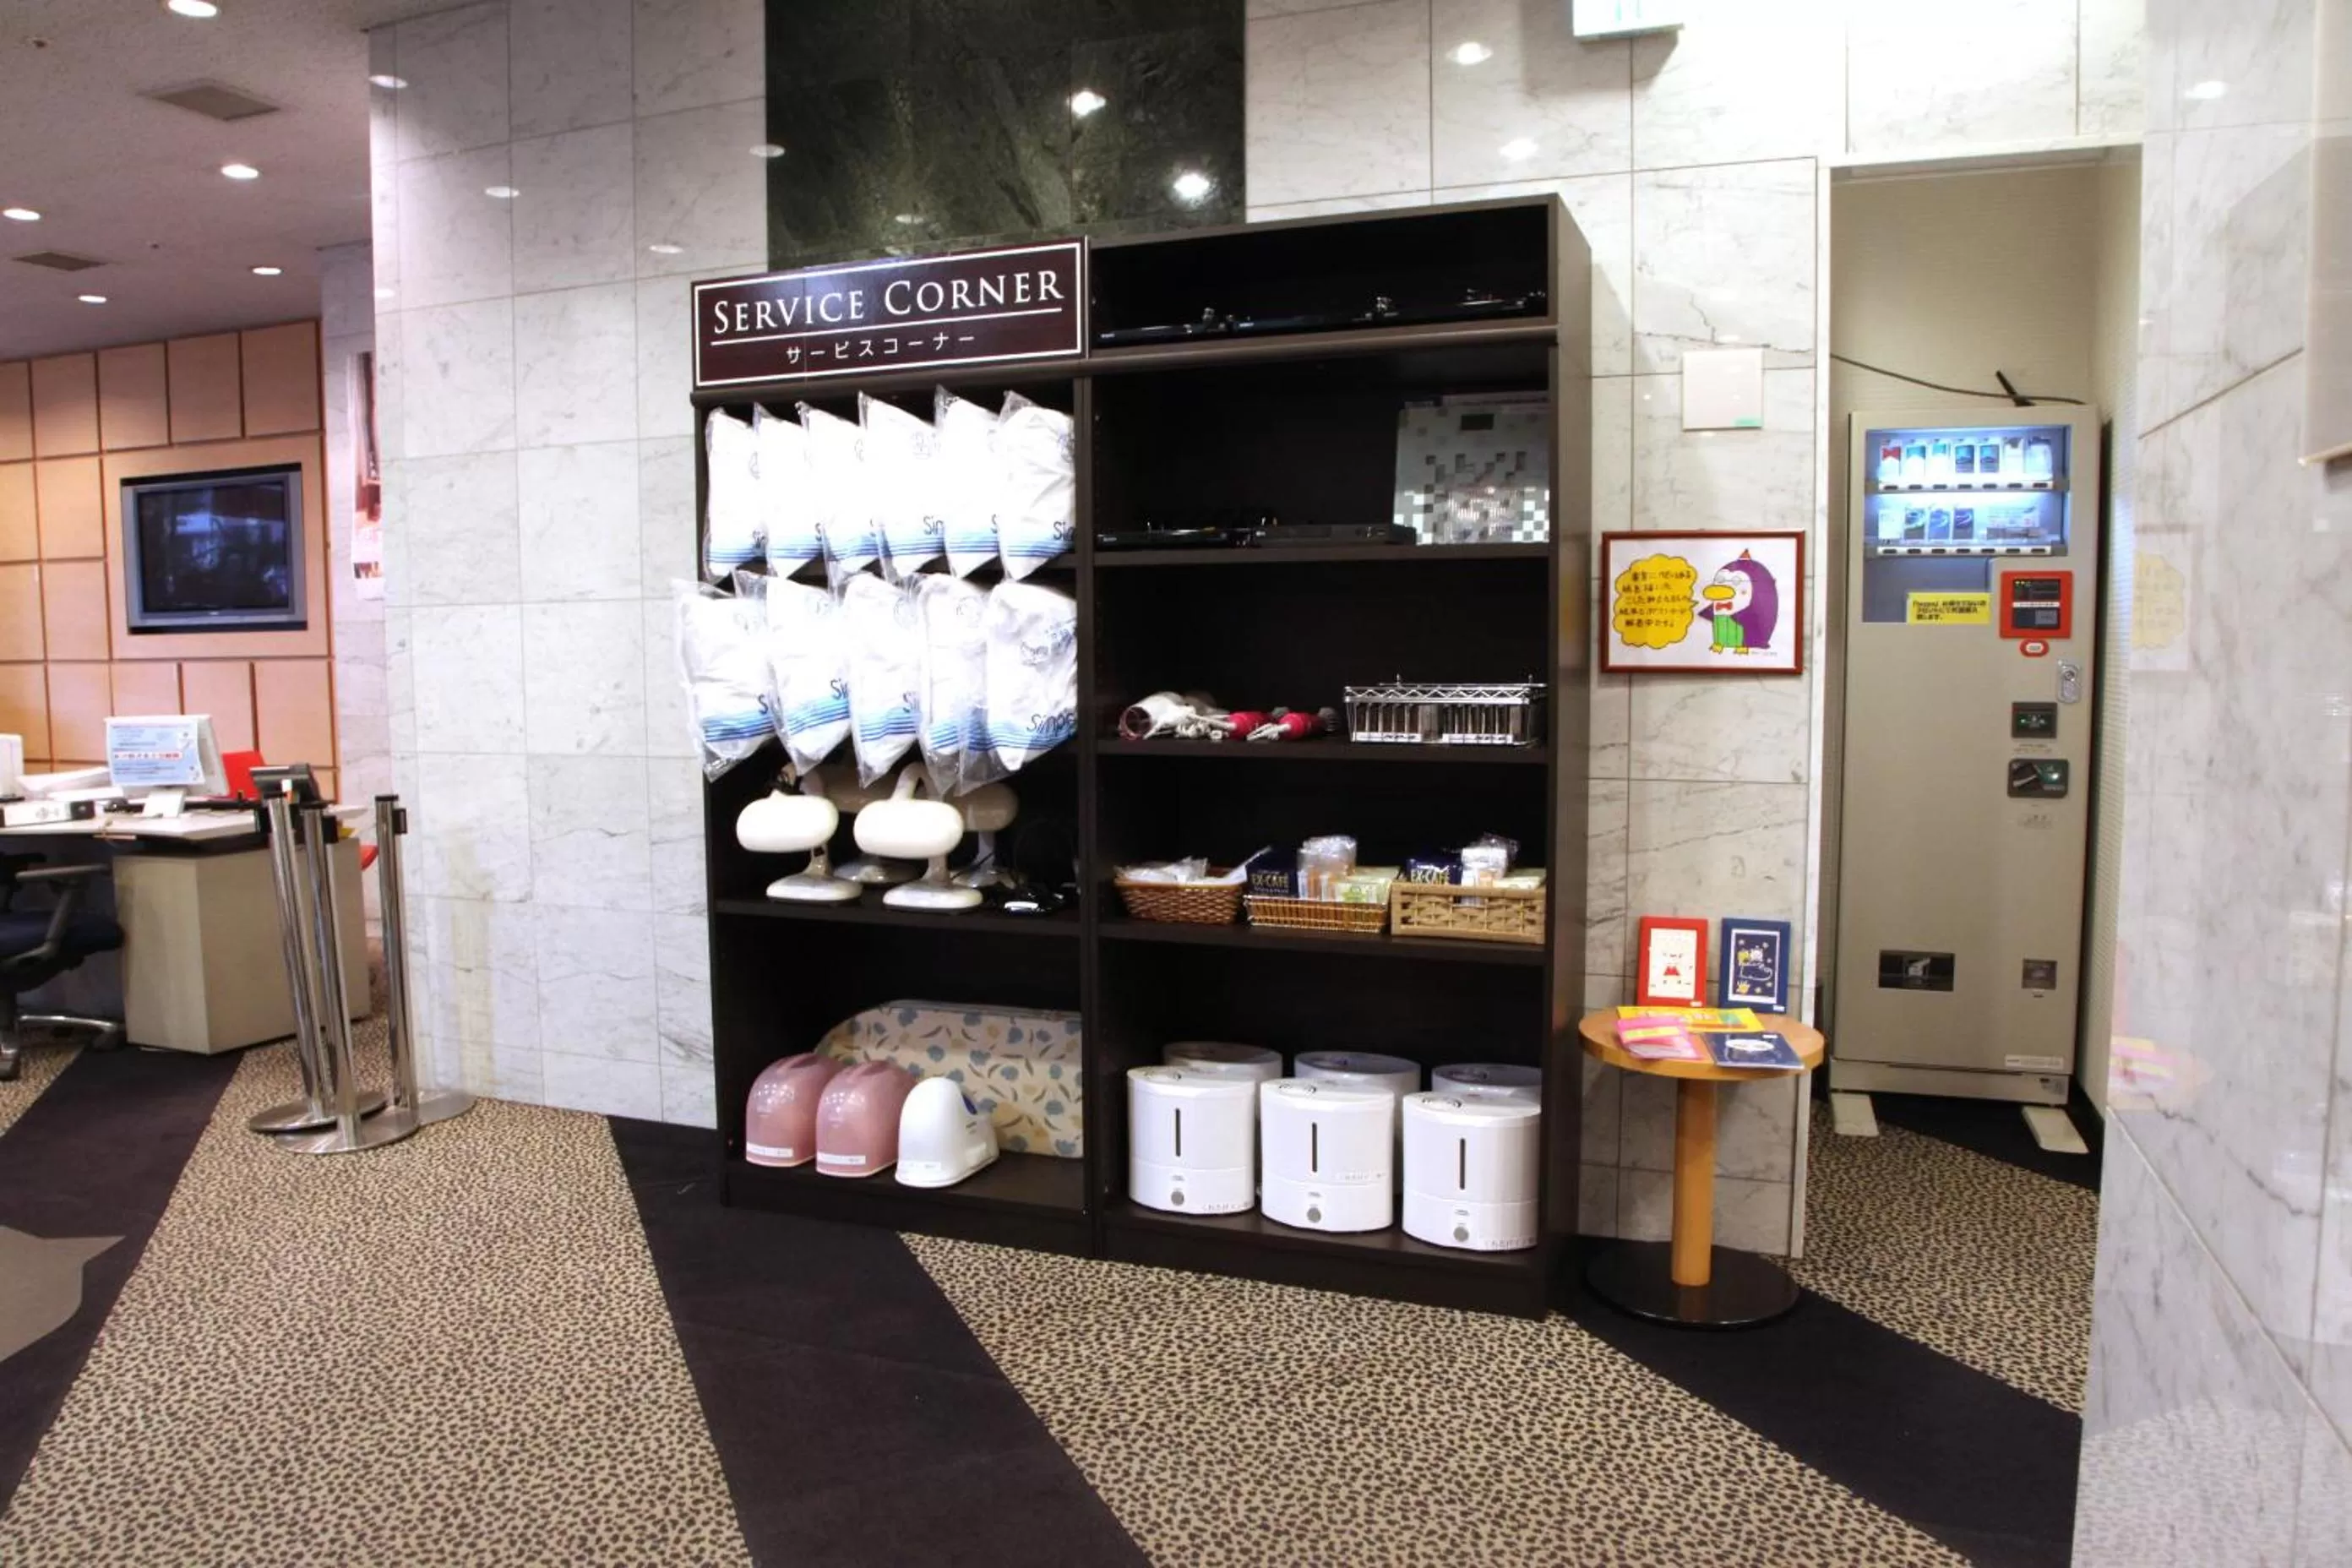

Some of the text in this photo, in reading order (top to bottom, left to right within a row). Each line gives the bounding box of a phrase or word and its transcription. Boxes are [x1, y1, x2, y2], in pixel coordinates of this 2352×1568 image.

[713, 270, 1064, 335] SERVICE CORNER
[786, 331, 975, 364] サービスコーナー
